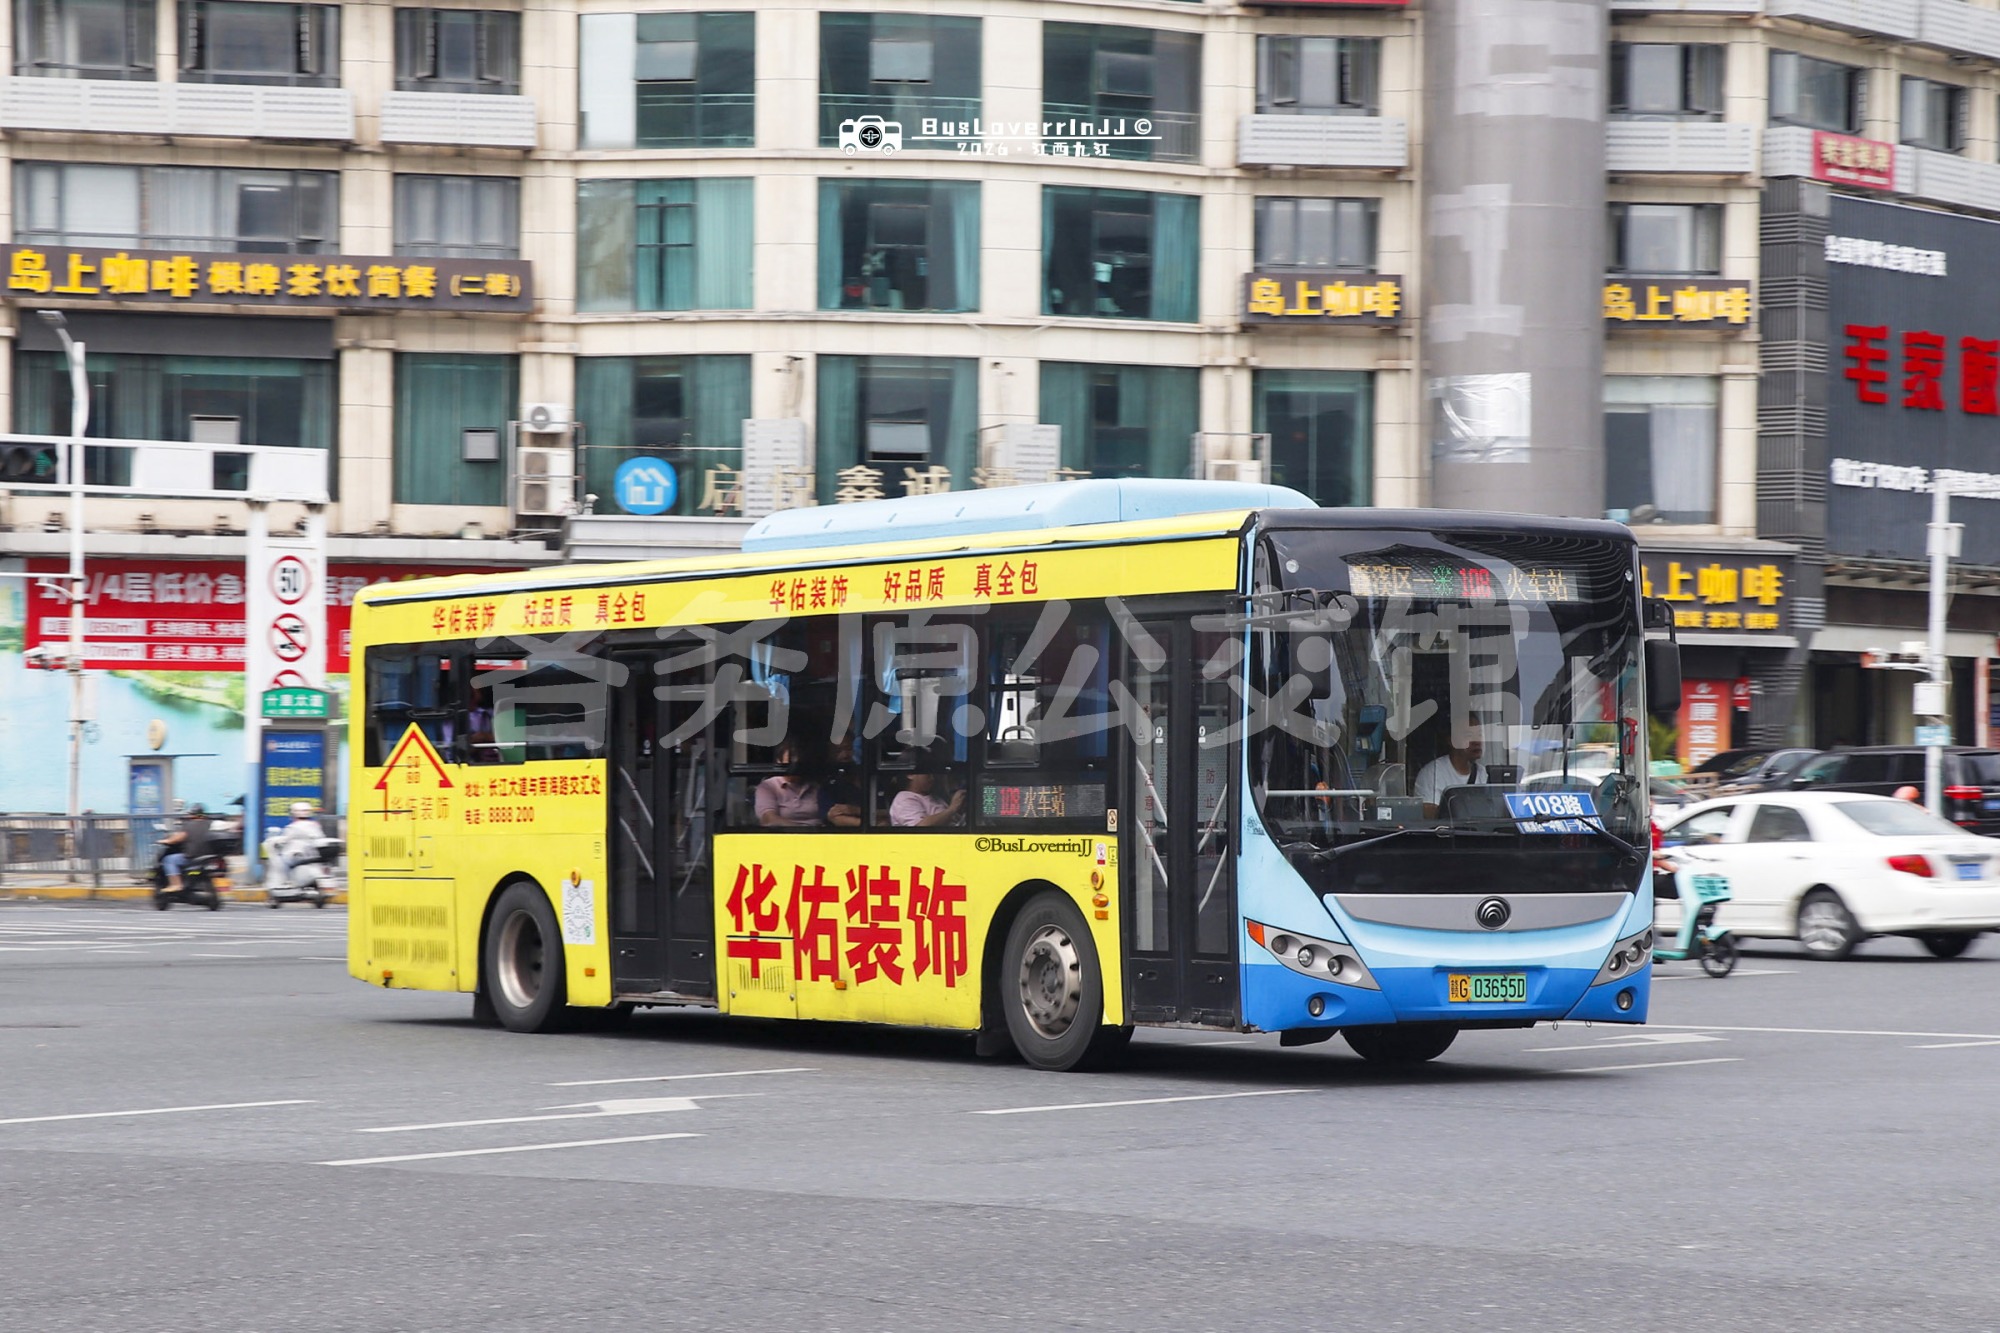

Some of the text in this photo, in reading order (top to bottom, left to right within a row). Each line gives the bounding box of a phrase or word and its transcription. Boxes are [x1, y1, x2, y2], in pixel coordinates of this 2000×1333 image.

[8, 249, 199, 297] 岛上咖啡
[286, 264, 361, 297] 茶饮
[1247, 278, 1401, 317] 岛上咖啡
[1603, 284, 1752, 324] 岛上咖啡
[769, 559, 1039, 613] 华佑装饰 好品质 真全包
[1507, 567, 1568, 601] 火车站
[432, 591, 645, 635] 华佑装饰 好品质 真全包
[1023, 785, 1066, 818] 火车站
[1522, 795, 1584, 815] 108路
[726, 863, 968, 988] 华佑装饰
